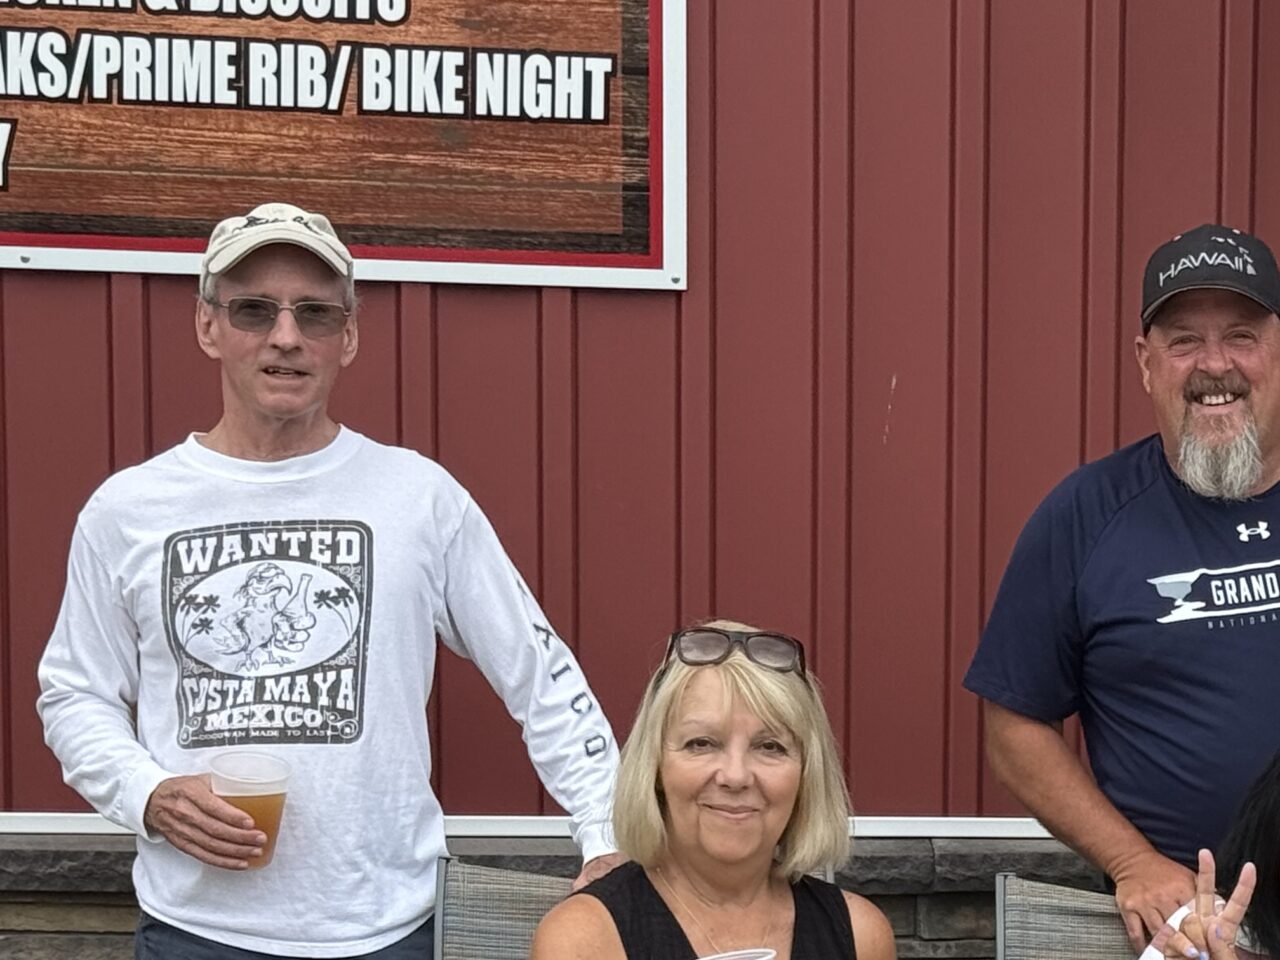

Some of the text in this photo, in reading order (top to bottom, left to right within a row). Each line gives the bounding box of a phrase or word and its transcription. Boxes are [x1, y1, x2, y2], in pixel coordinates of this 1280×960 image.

[249, 42, 351, 111] RIB/
[363, 47, 465, 115] BIKE
[475, 52, 612, 120] NIGHT
[1158, 252, 1244, 287] HAWAII
[176, 531, 361, 575] WANTED
[1210, 572, 1280, 606] GRAND
[183, 668, 355, 718] COSTA MAYA
[204, 703, 323, 731] MEXICO
[249, 729, 280, 738] MADE
[287, 729, 301, 737] TO
[306, 729, 331, 737] LAST
